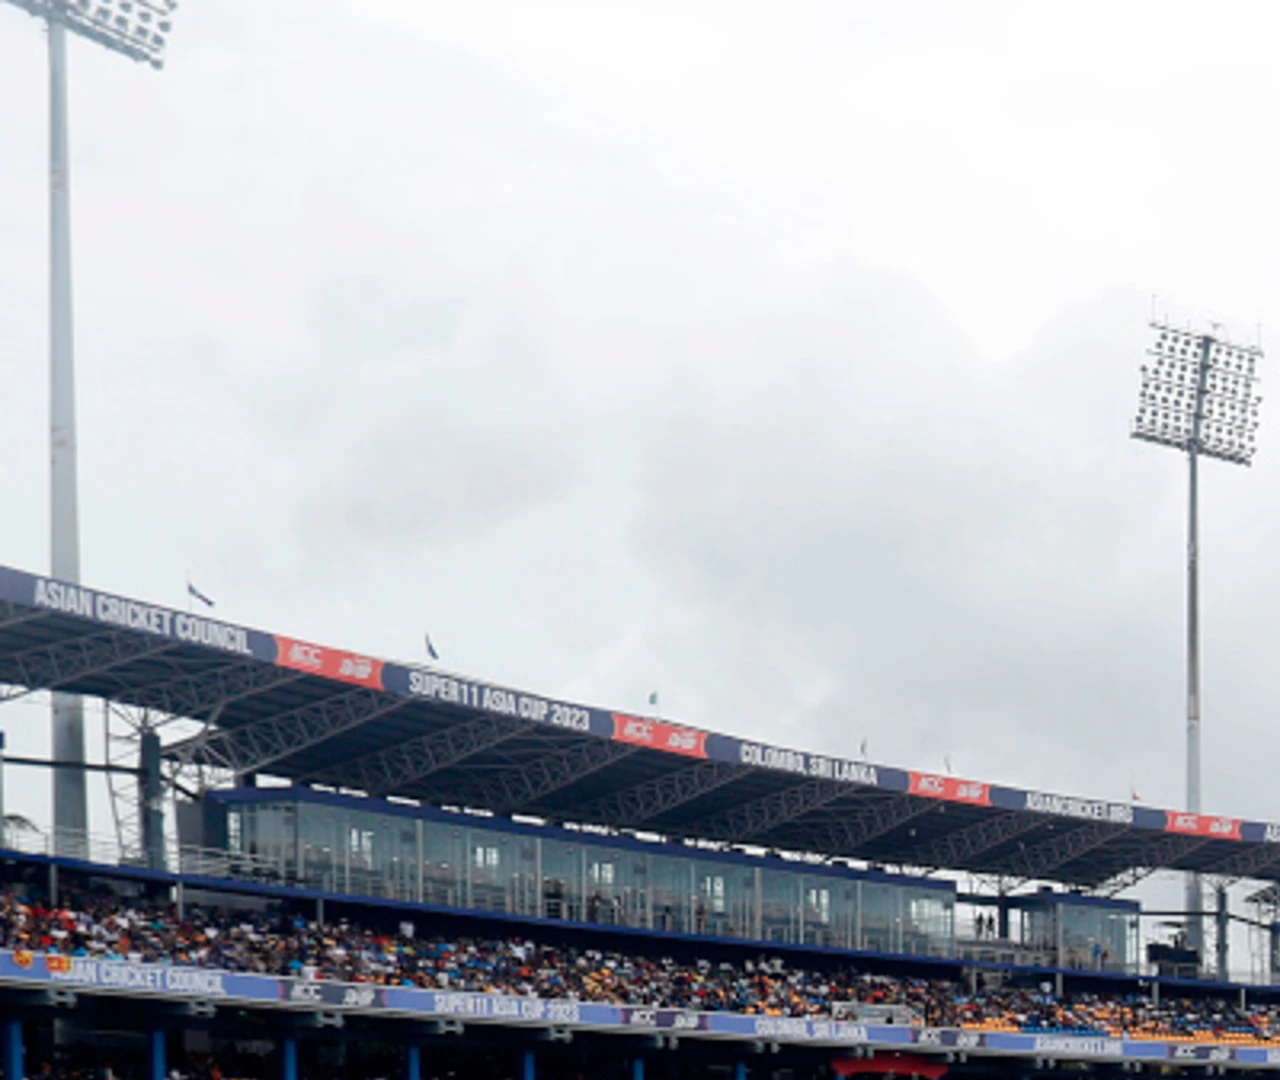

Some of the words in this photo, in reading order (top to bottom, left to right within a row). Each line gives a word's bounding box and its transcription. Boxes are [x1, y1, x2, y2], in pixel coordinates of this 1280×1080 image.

[35, 578, 92, 618] ASIAN
[96, 594, 173, 638] CRICKET
[175, 613, 253, 656] COUNCIL
[483, 688, 516, 715] ASIA
[518, 695, 549, 722] CUP
[550, 702, 590, 731] 2023
[809, 757, 832, 779] SRI
[835, 760, 878, 786] LANKA
[101, 961, 163, 989] CRICKET
[166, 968, 227, 996] COUNCIL
[521, 998, 544, 1019] CUP
